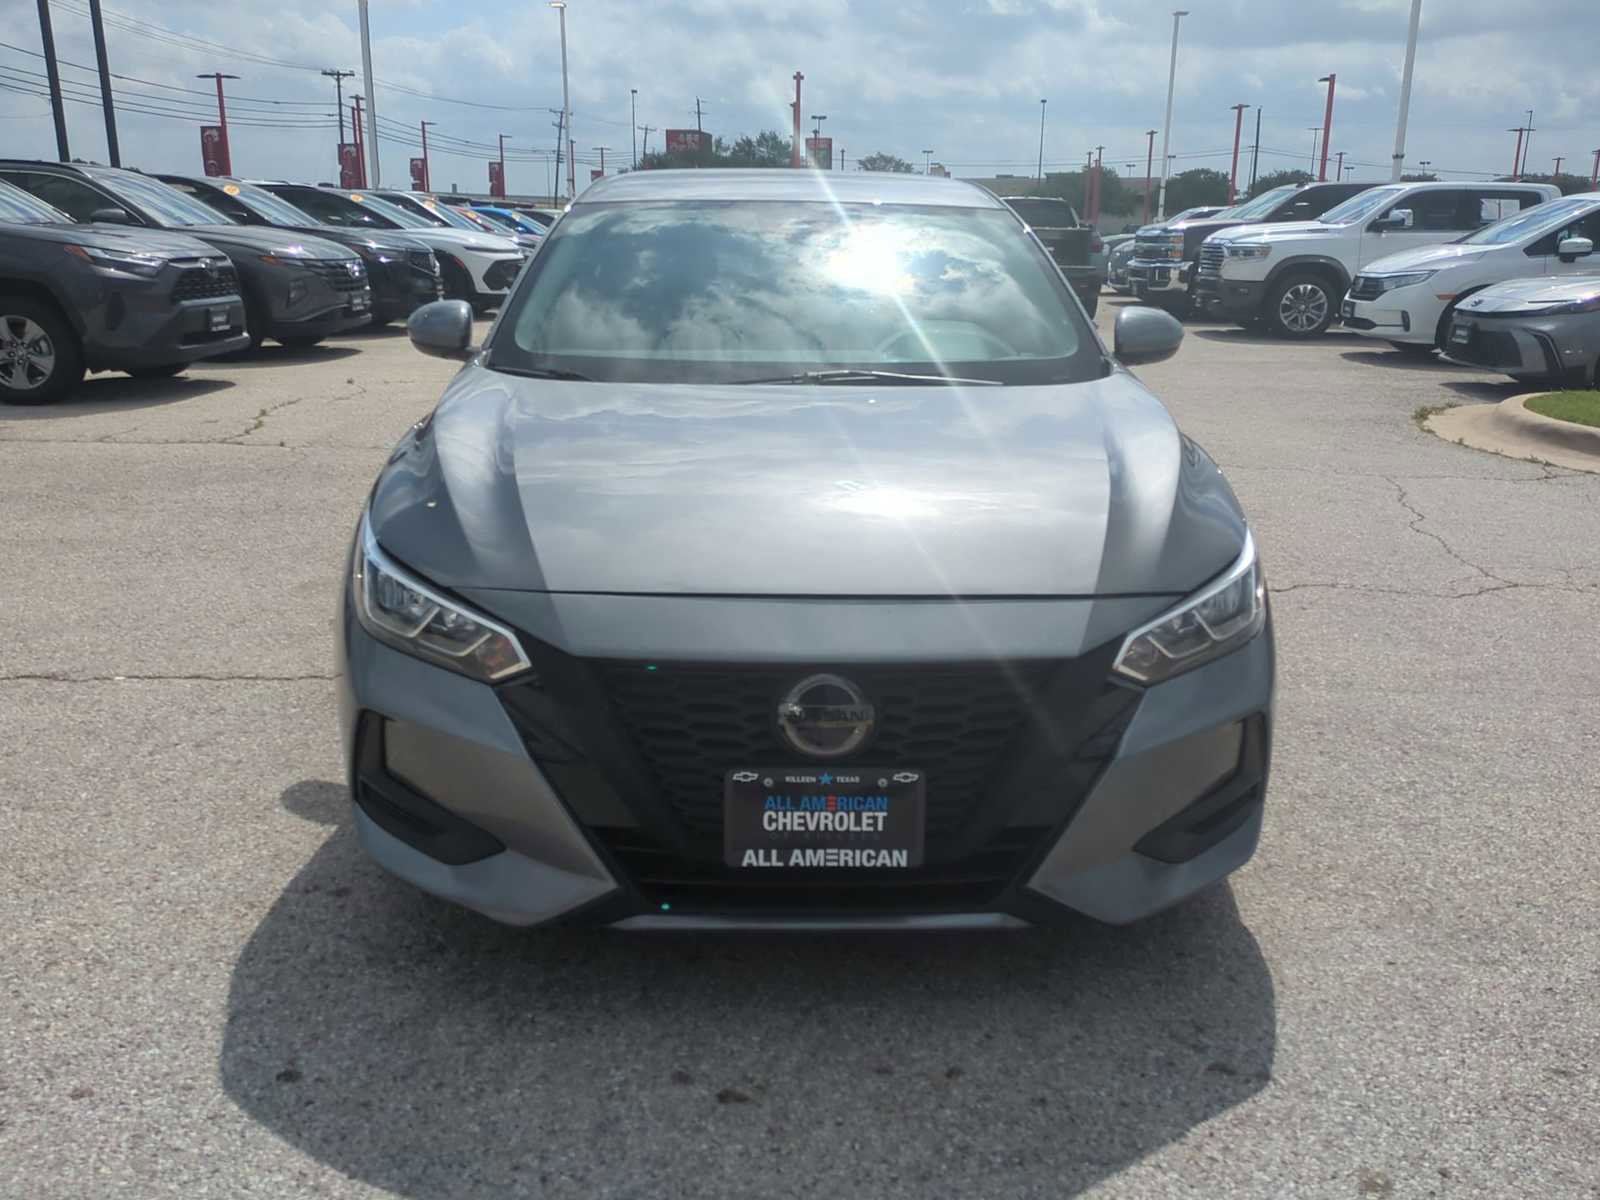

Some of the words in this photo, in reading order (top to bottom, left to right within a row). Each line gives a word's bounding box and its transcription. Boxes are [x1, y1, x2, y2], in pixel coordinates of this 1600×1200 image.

[765, 795, 795, 811] ALL
[800, 795, 888, 811] AMERICAN
[763, 811, 887, 832] CHEVROLET
[742, 849, 784, 867] ALL
[789, 848, 907, 867] AMERICAN
